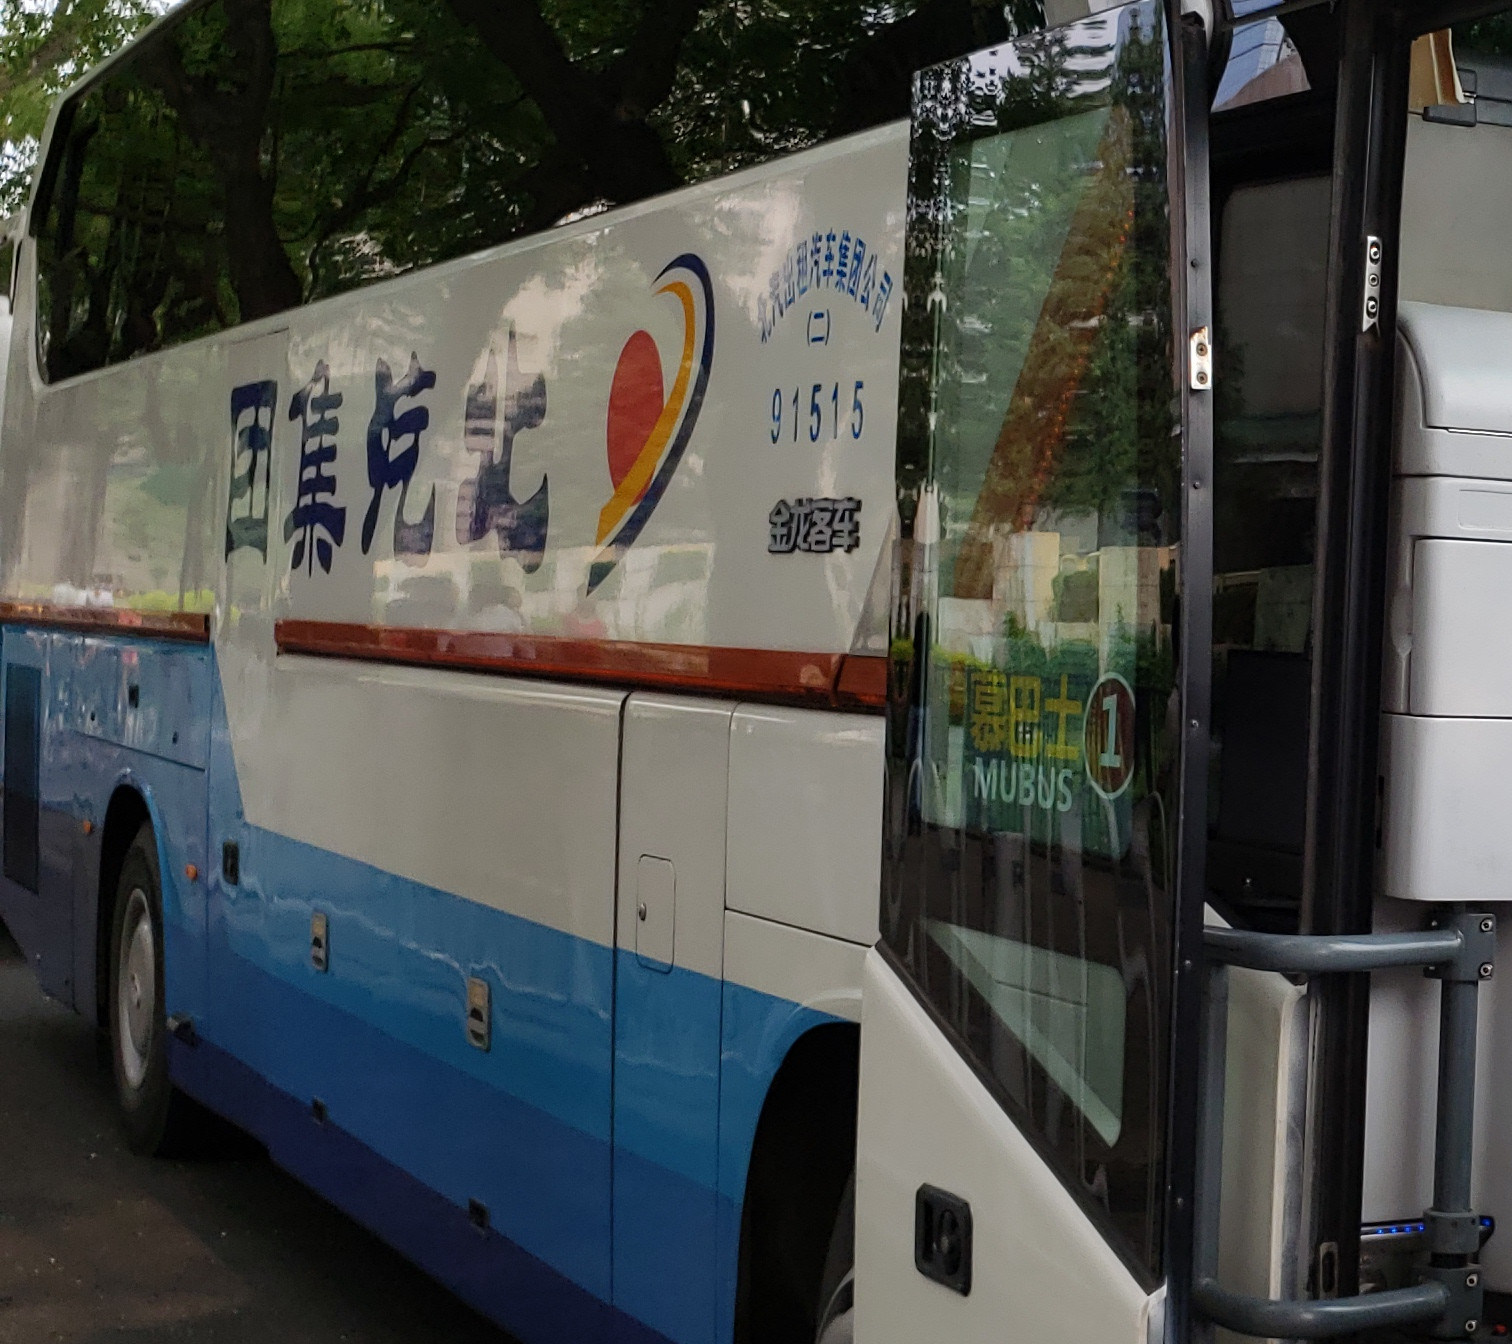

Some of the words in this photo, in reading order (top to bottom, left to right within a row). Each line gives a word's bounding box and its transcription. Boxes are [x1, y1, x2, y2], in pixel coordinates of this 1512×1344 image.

[771, 380, 864, 444] 91515
[767, 497, 863, 553] 金龙客车
[974, 757, 1073, 812] MUBUS
